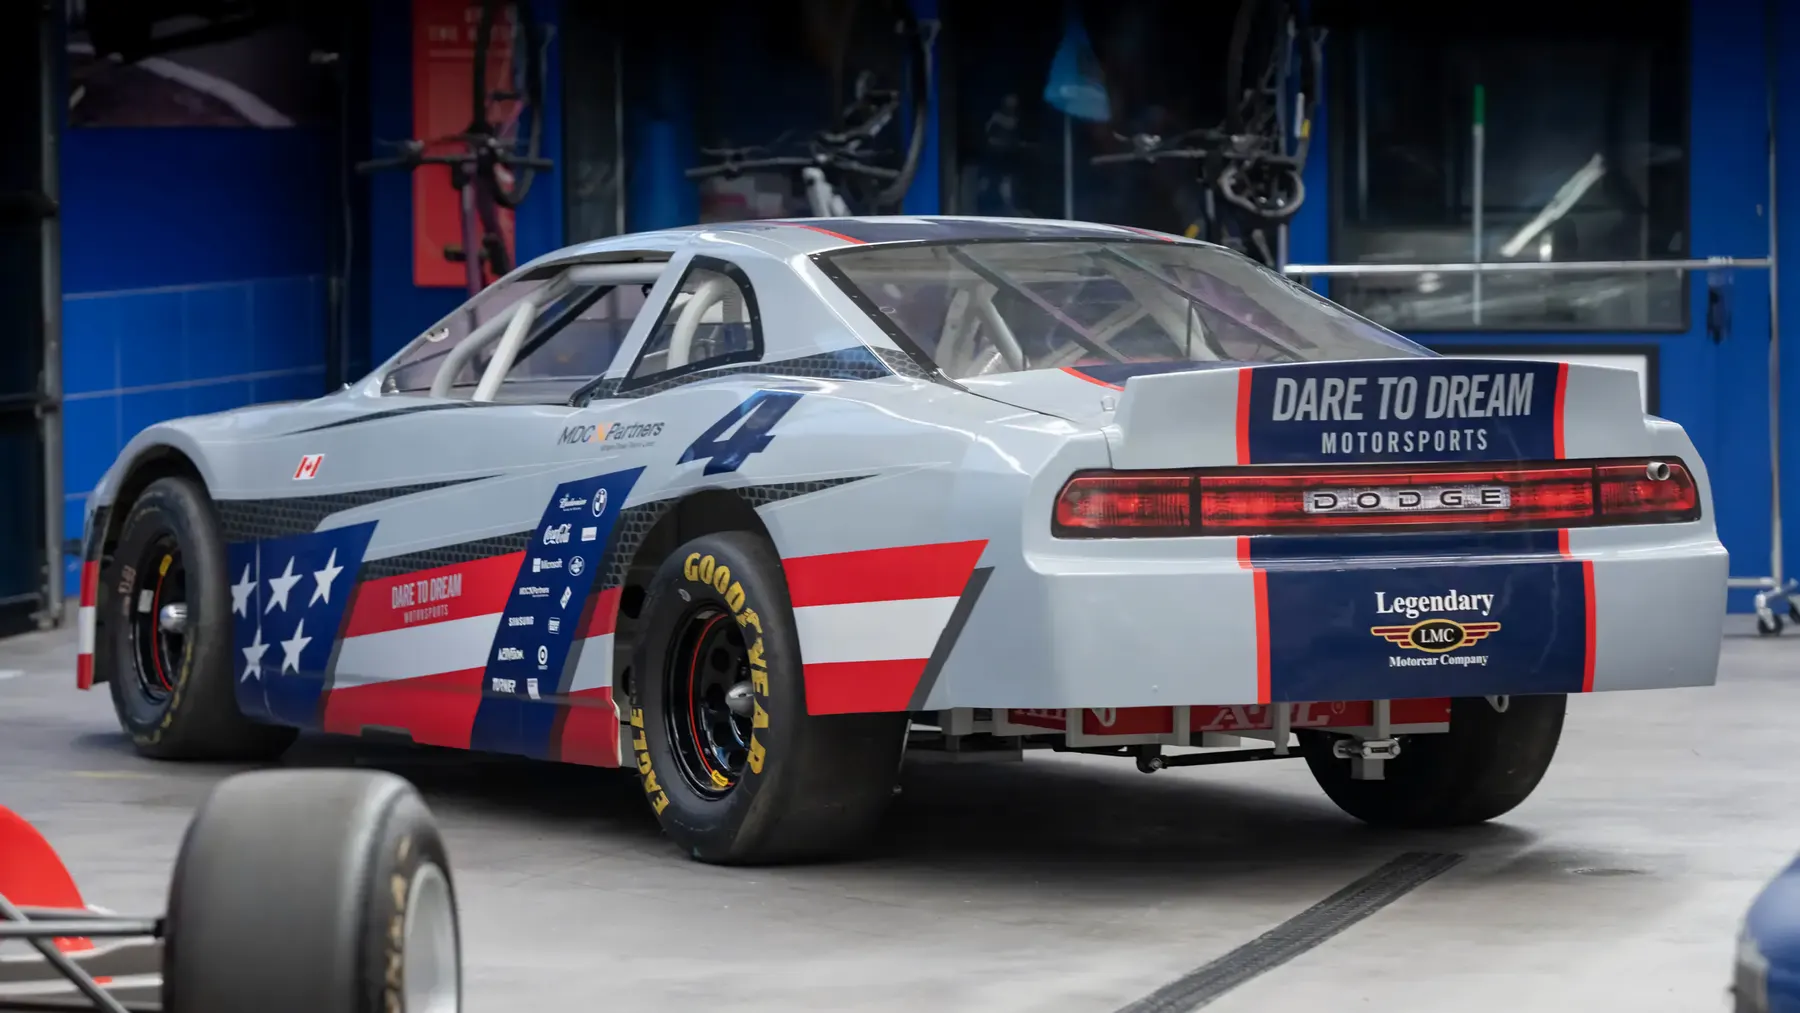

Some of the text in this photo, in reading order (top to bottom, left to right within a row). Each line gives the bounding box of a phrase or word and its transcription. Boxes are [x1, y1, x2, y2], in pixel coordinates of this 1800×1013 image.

[1272, 373, 1534, 421] DARE TO DREAM
[557, 422, 665, 445] MDC Partners
[676, 389, 805, 477] 4
[1322, 429, 1488, 454] MOTORSPORTS
[1313, 489, 1502, 509] DODGE
[391, 573, 462, 609] DARE TO DREAM
[1374, 589, 1494, 619] Legendary
[508, 616, 535, 627] SAMSUNG
[1420, 628, 1455, 643] LMC
[684, 552, 770, 775] GOODYEAR
[1389, 654, 1489, 668] Motorcar Company
[630, 708, 670, 815] EAGLE
